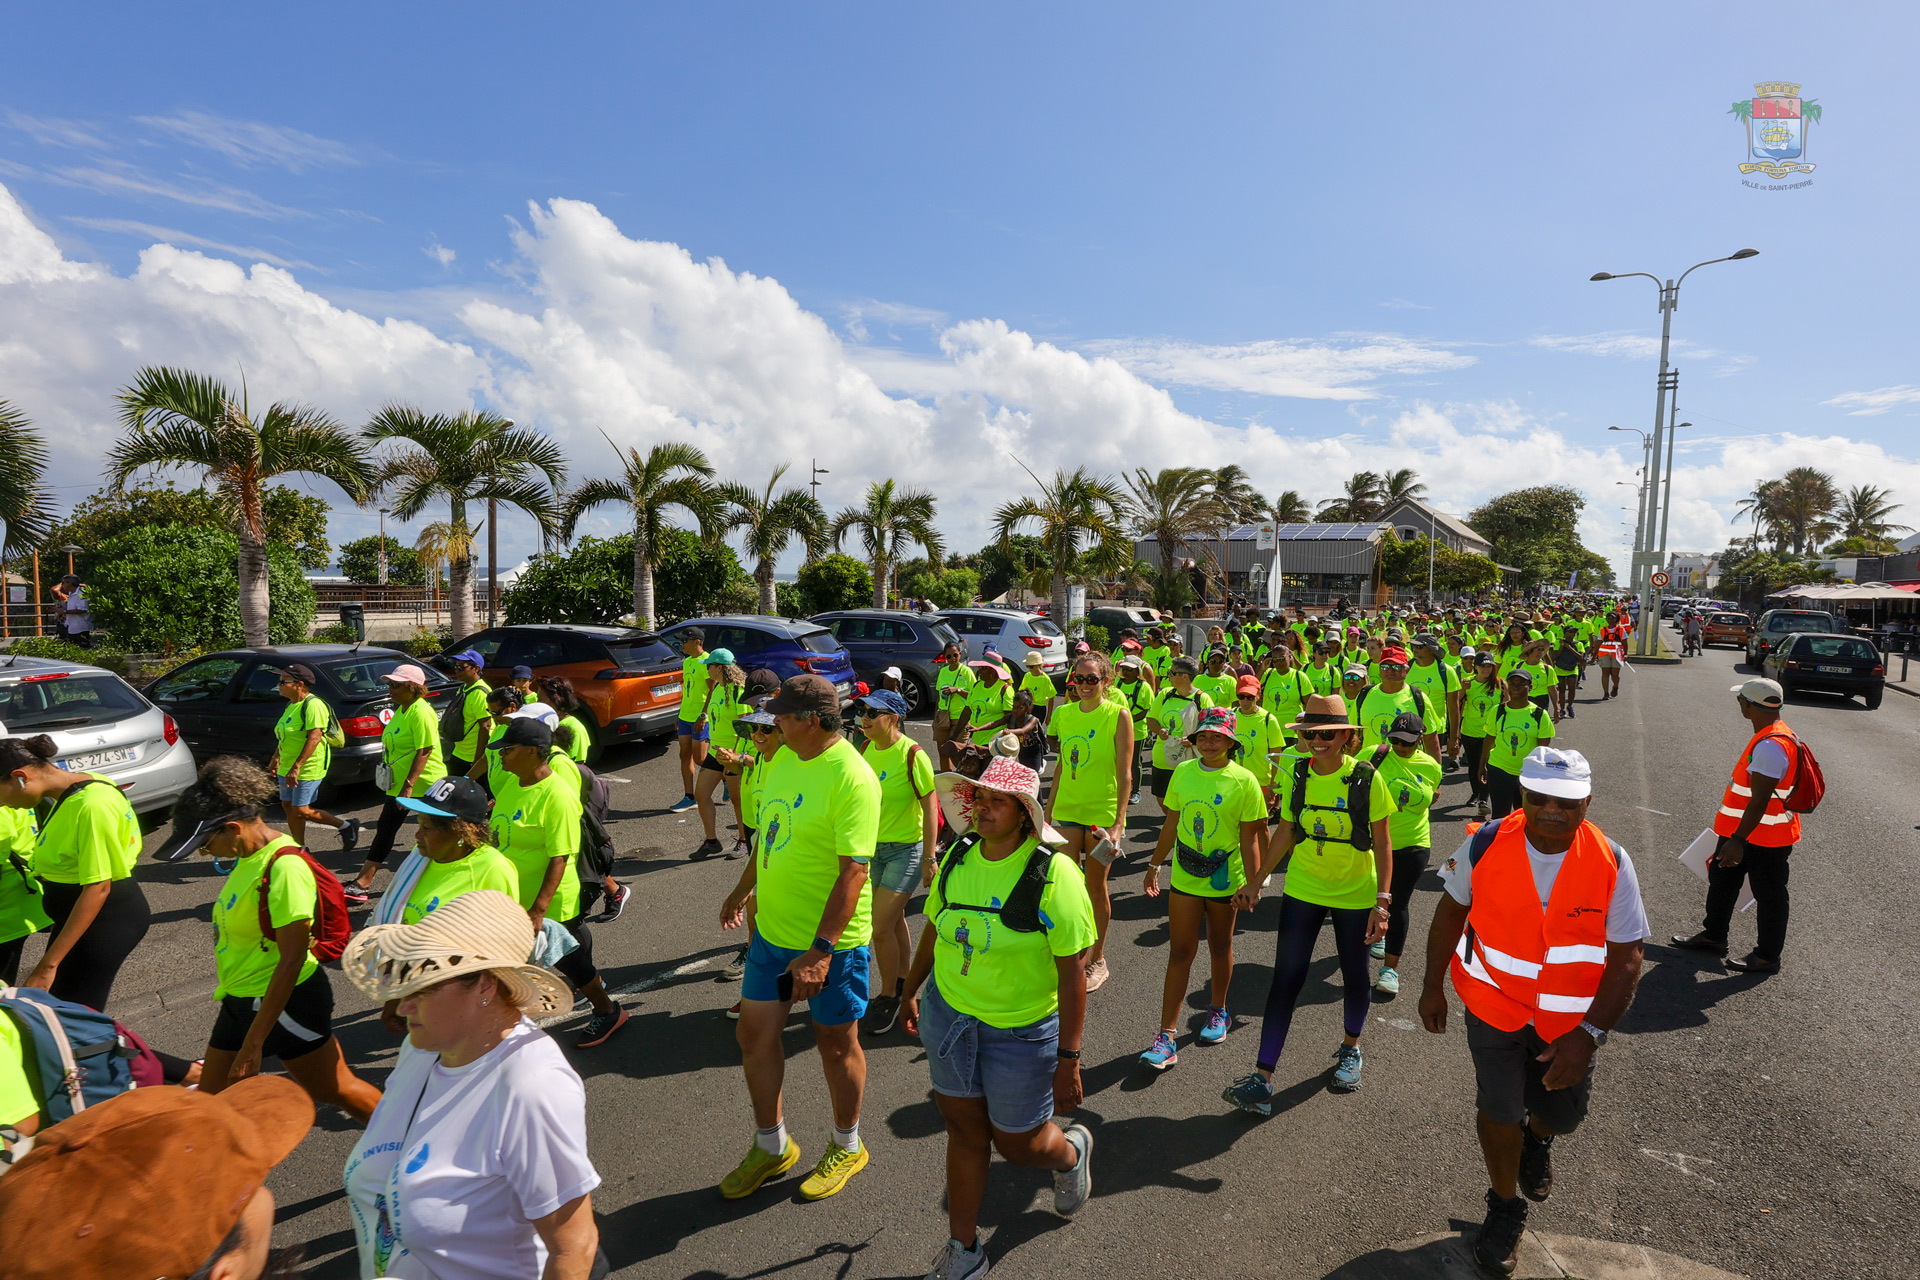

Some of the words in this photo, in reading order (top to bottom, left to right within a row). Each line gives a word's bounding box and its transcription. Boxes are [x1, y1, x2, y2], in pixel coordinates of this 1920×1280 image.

[384, 710, 393, 722] A
[67, 750, 128, 771] CS-274-SW
[363, 1141, 403, 1160] INVISI
